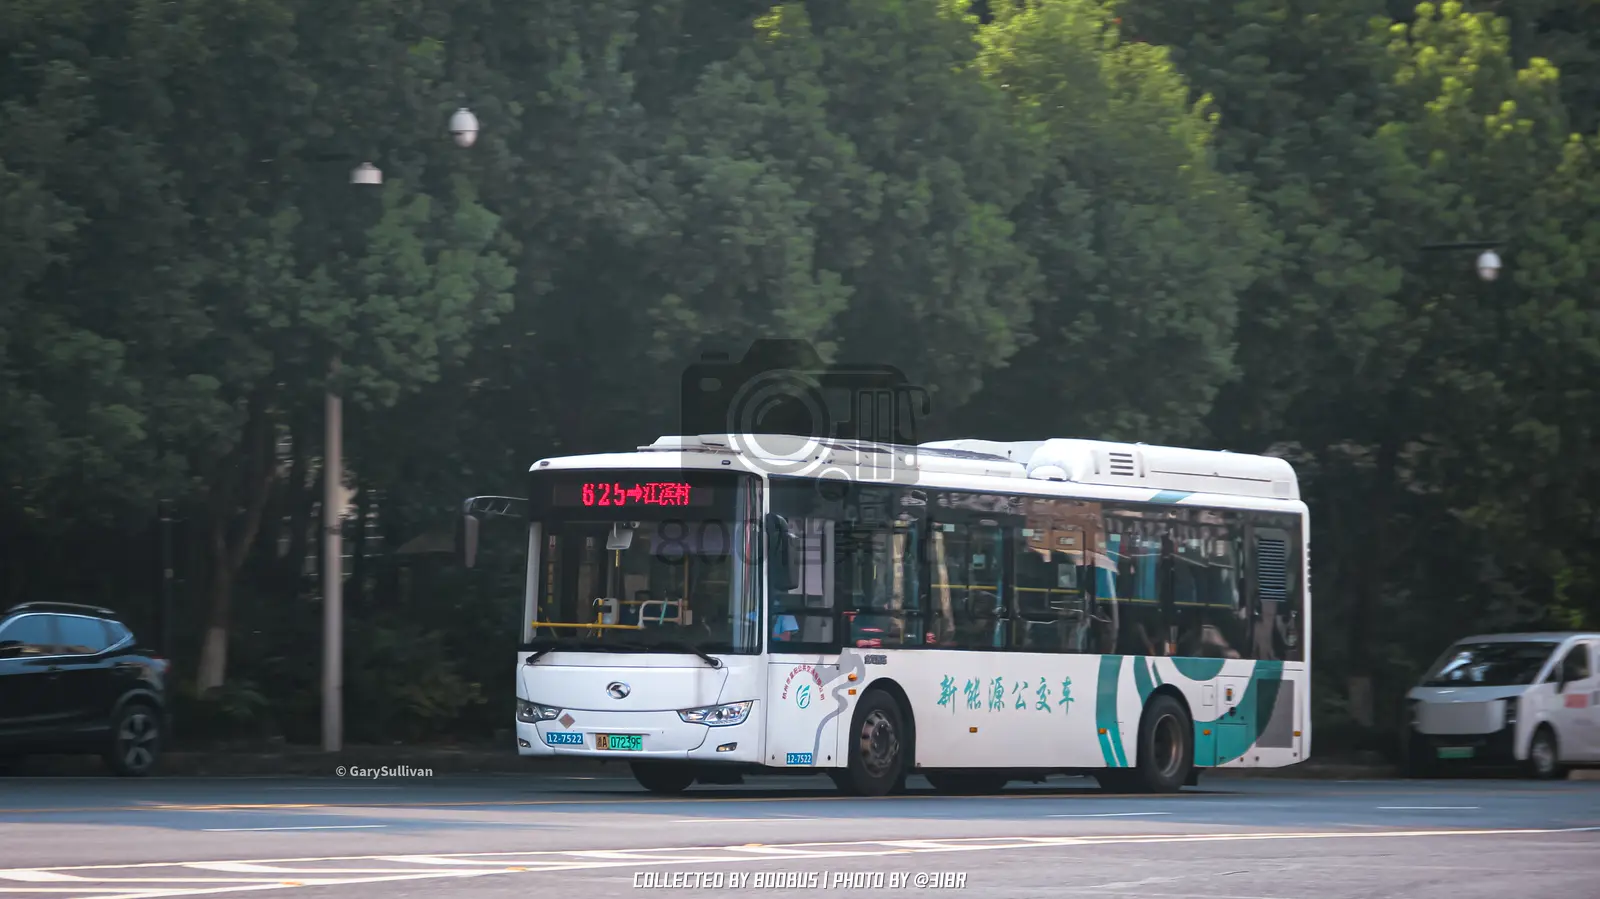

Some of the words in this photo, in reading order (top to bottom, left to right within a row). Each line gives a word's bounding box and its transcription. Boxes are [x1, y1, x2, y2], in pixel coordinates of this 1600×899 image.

[582, 482, 627, 507] 625
[643, 482, 692, 507] 江滨村
[937, 674, 1076, 715] 新能源公交车
[547, 734, 582, 744] 12-7522
[787, 754, 812, 764] 12-7522
